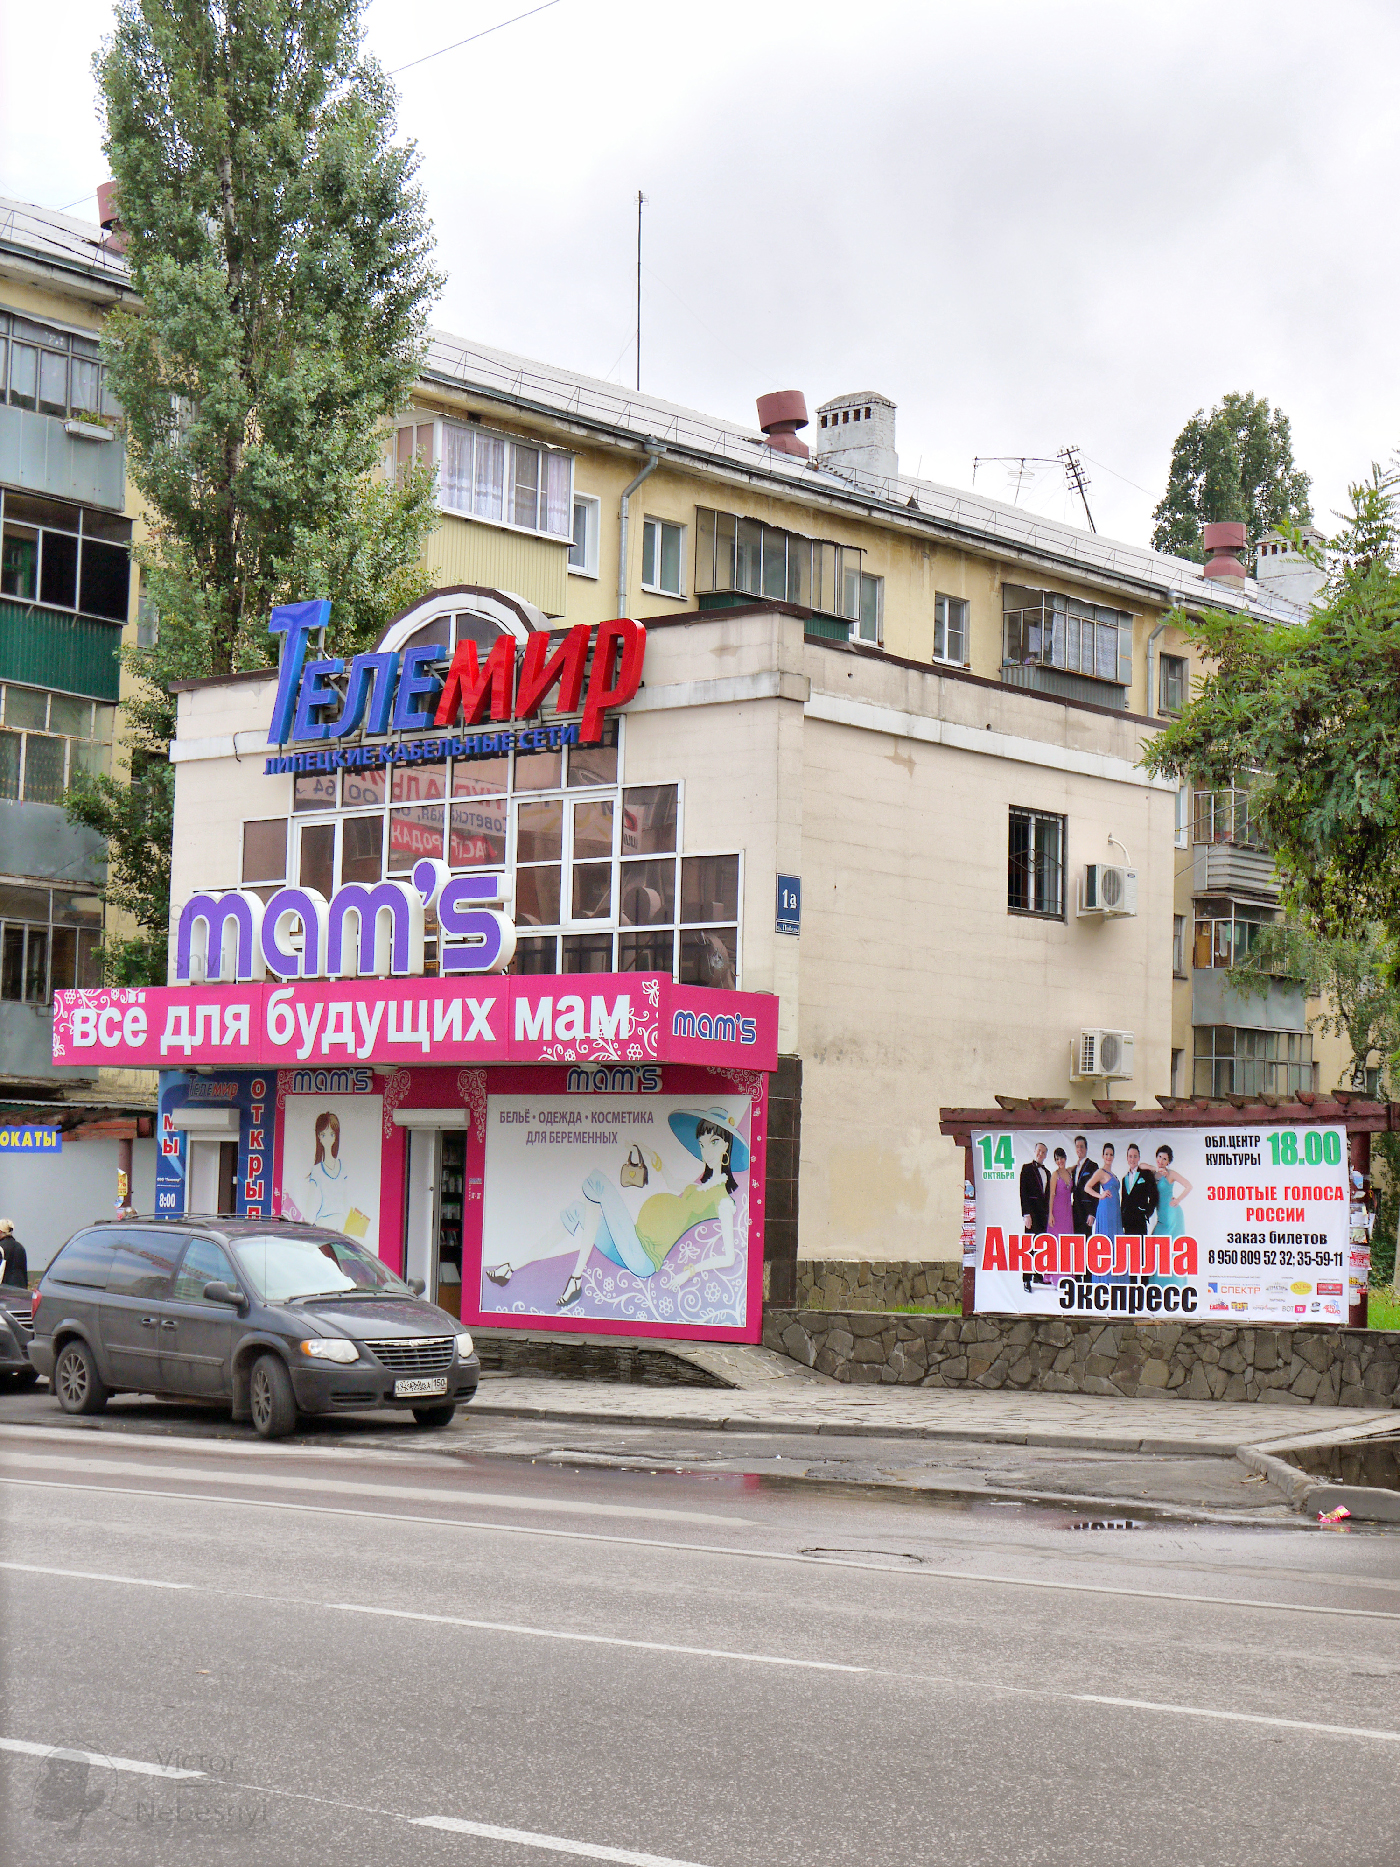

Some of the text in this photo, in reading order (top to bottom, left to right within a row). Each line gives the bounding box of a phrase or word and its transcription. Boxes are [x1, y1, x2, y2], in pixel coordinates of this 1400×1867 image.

[263, 725, 580, 775] ЛИПЕЦКИЕ КАБЕЛЬНЫЕ СЕТИ
[176, 857, 517, 986] mam's
[72, 987, 631, 1060] всё для будущих мам
[672, 1009, 757, 1045] mam's
[292, 1068, 374, 1093] mam's
[567, 1066, 663, 1092] mam's
[499, 1109, 654, 1126] БЕЛЬЁ ОДЕЖДА КОСМЕТИКА
[526, 1131, 618, 1145] ДЛЯ БЕРЕМЕННЫХ
[1266, 1131, 1341, 1166] 18.00
[977, 1135, 1015, 1170] 14
[1205, 1153, 1261, 1166] КУЛЬТУРЫ
[983, 1171, 1015, 1180] ОКТЯБРЯ
[159, 1192, 176, 1208] 8:00
[1207, 1186, 1345, 1201] ЗОЛОТЫЕ ГОЛОСА
[1246, 1207, 1305, 1222] РОССИИ
[1227, 1231, 1328, 1245] заказ билетов
[981, 1226, 1198, 1277] Акапелла
[1208, 1249, 1215, 1265] 8
[1217, 1249, 1238, 1265] 950
[1240, 1249, 1261, 1265] 809
[1263, 1250, 1277, 1265] 52
[1058, 1278, 1198, 1314] Экспресс
[1220, 1286, 1261, 1294] СПЕКТР
